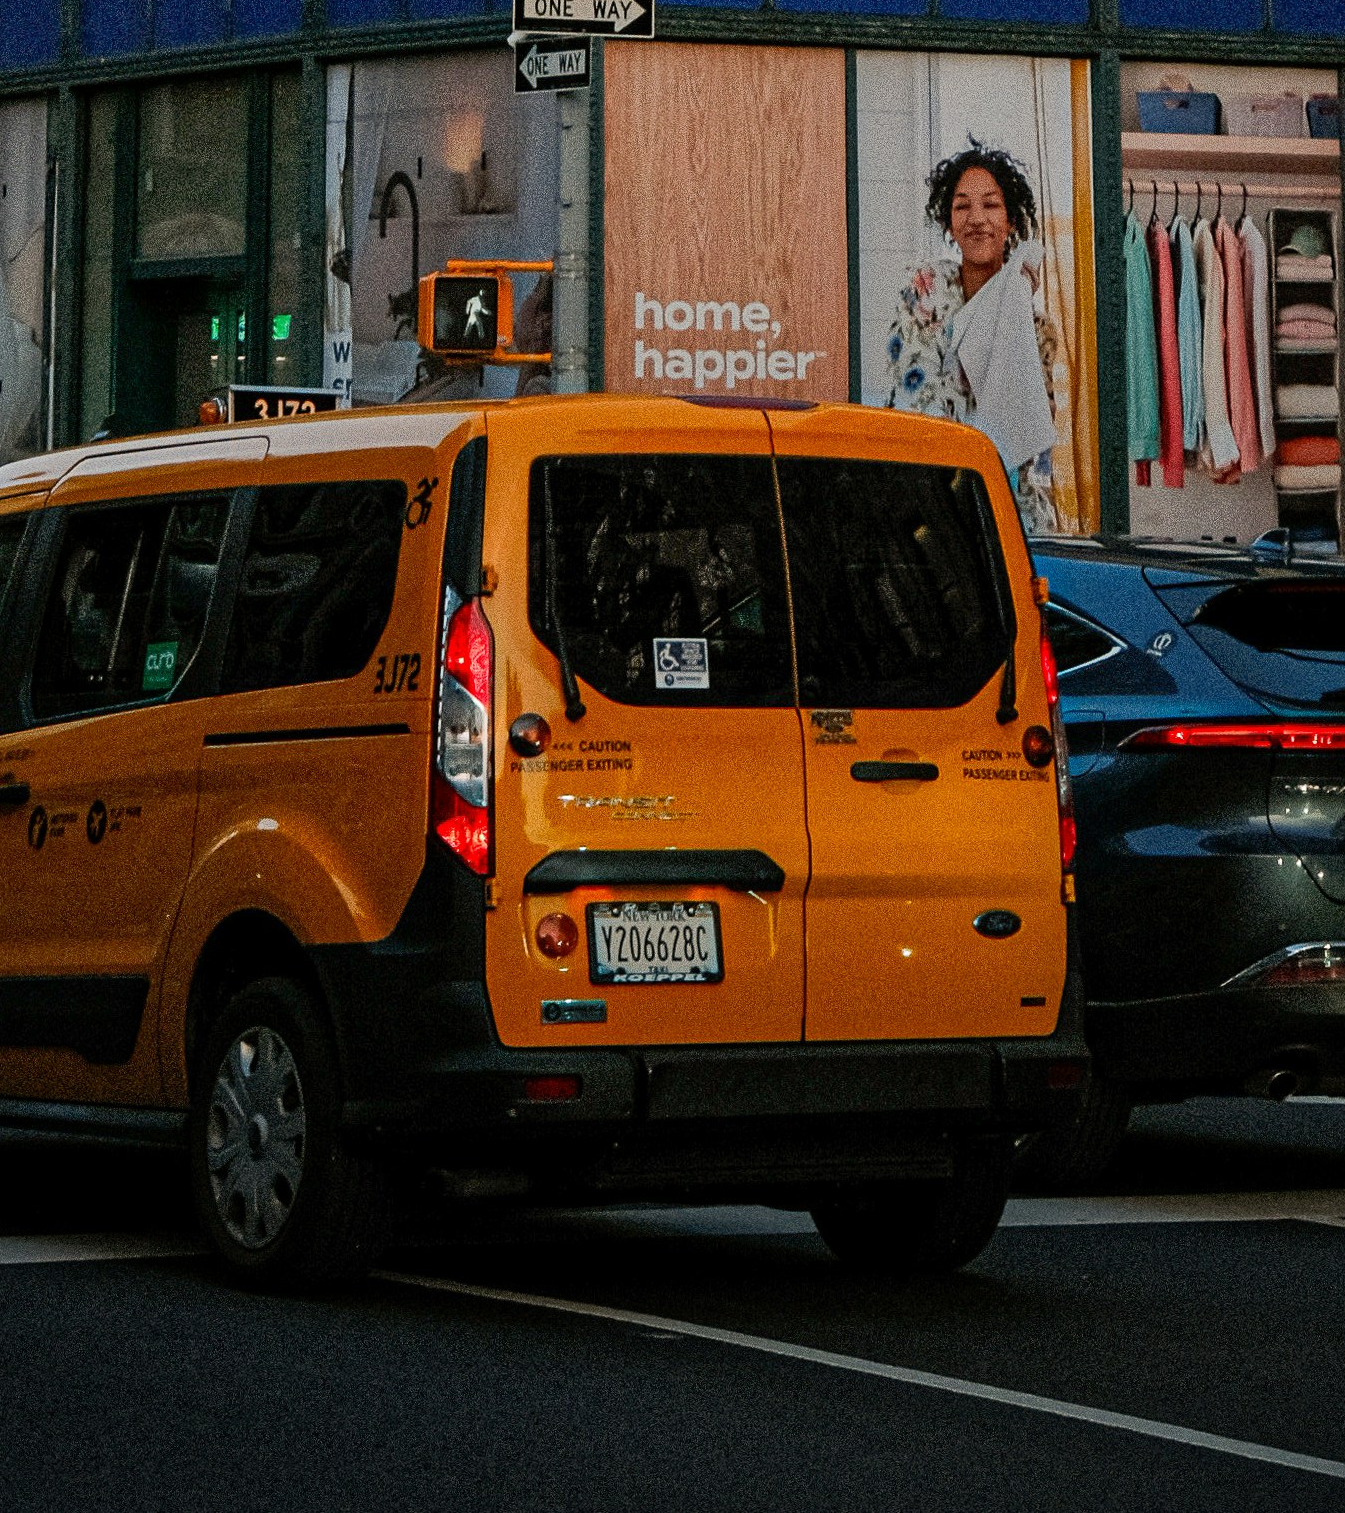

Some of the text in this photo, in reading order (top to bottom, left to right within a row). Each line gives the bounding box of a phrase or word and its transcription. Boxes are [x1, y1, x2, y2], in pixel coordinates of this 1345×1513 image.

[592, 0, 633, 20] WAY
[527, 51, 582, 76] ONE WAY
[634, 291, 782, 339] home,
[634, 339, 816, 389] happier
[373, 651, 421, 694] 3J72
[578, 739, 632, 754] CAUTION
[961, 749, 1002, 762] CAUTION
[510, 757, 633, 774] PASSENGER EXITING
[963, 767, 1018, 781] PASSENGER
[622, 910, 651, 923] NEW
[600, 925, 709, 963] Y206628C
[612, 973, 707, 983] KOEPPEL
